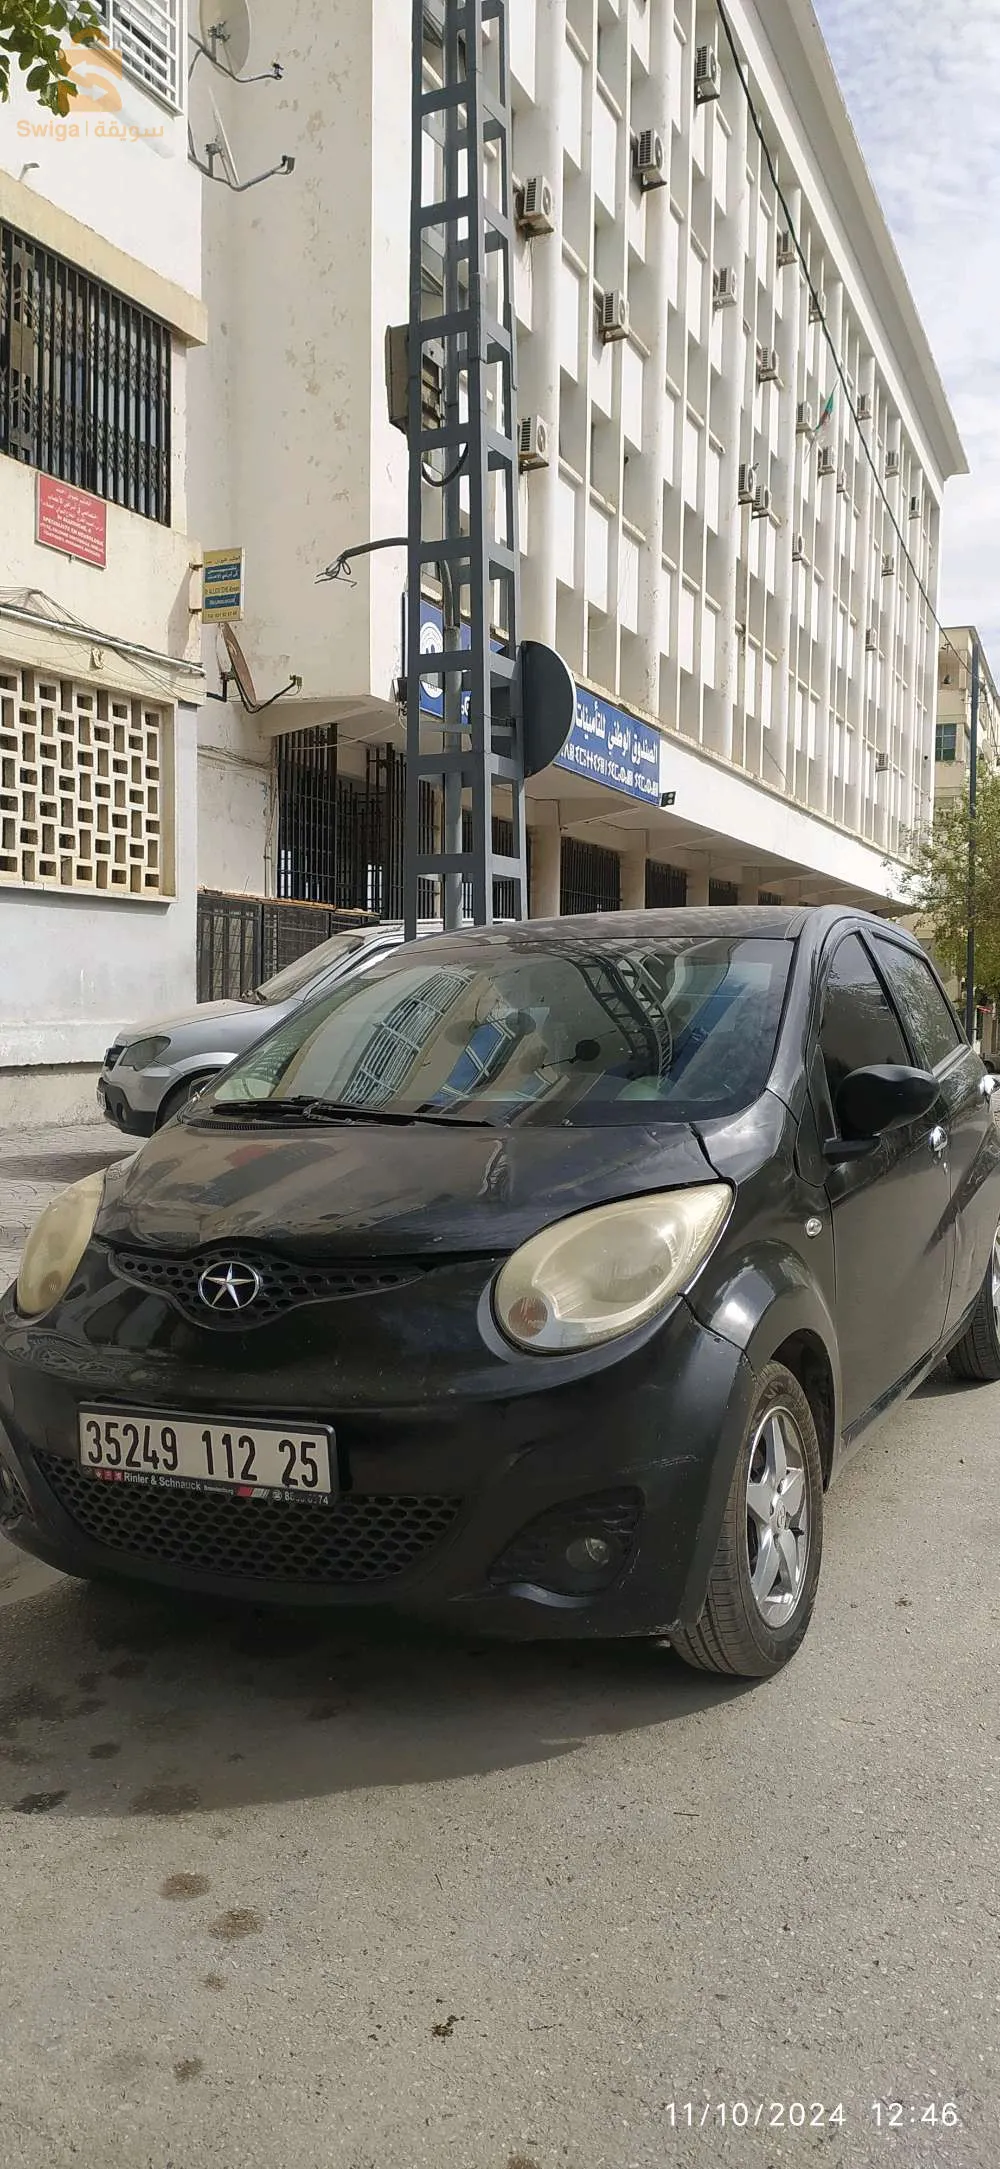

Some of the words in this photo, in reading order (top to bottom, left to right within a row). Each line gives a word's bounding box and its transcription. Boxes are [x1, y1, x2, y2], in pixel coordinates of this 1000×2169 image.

[607, 720, 632, 756] الوطني
[631, 733, 659, 765] الصندوق
[86, 1420, 178, 1472] 35249
[201, 1430, 258, 1482] 112
[278, 1439, 319, 1488] 25
